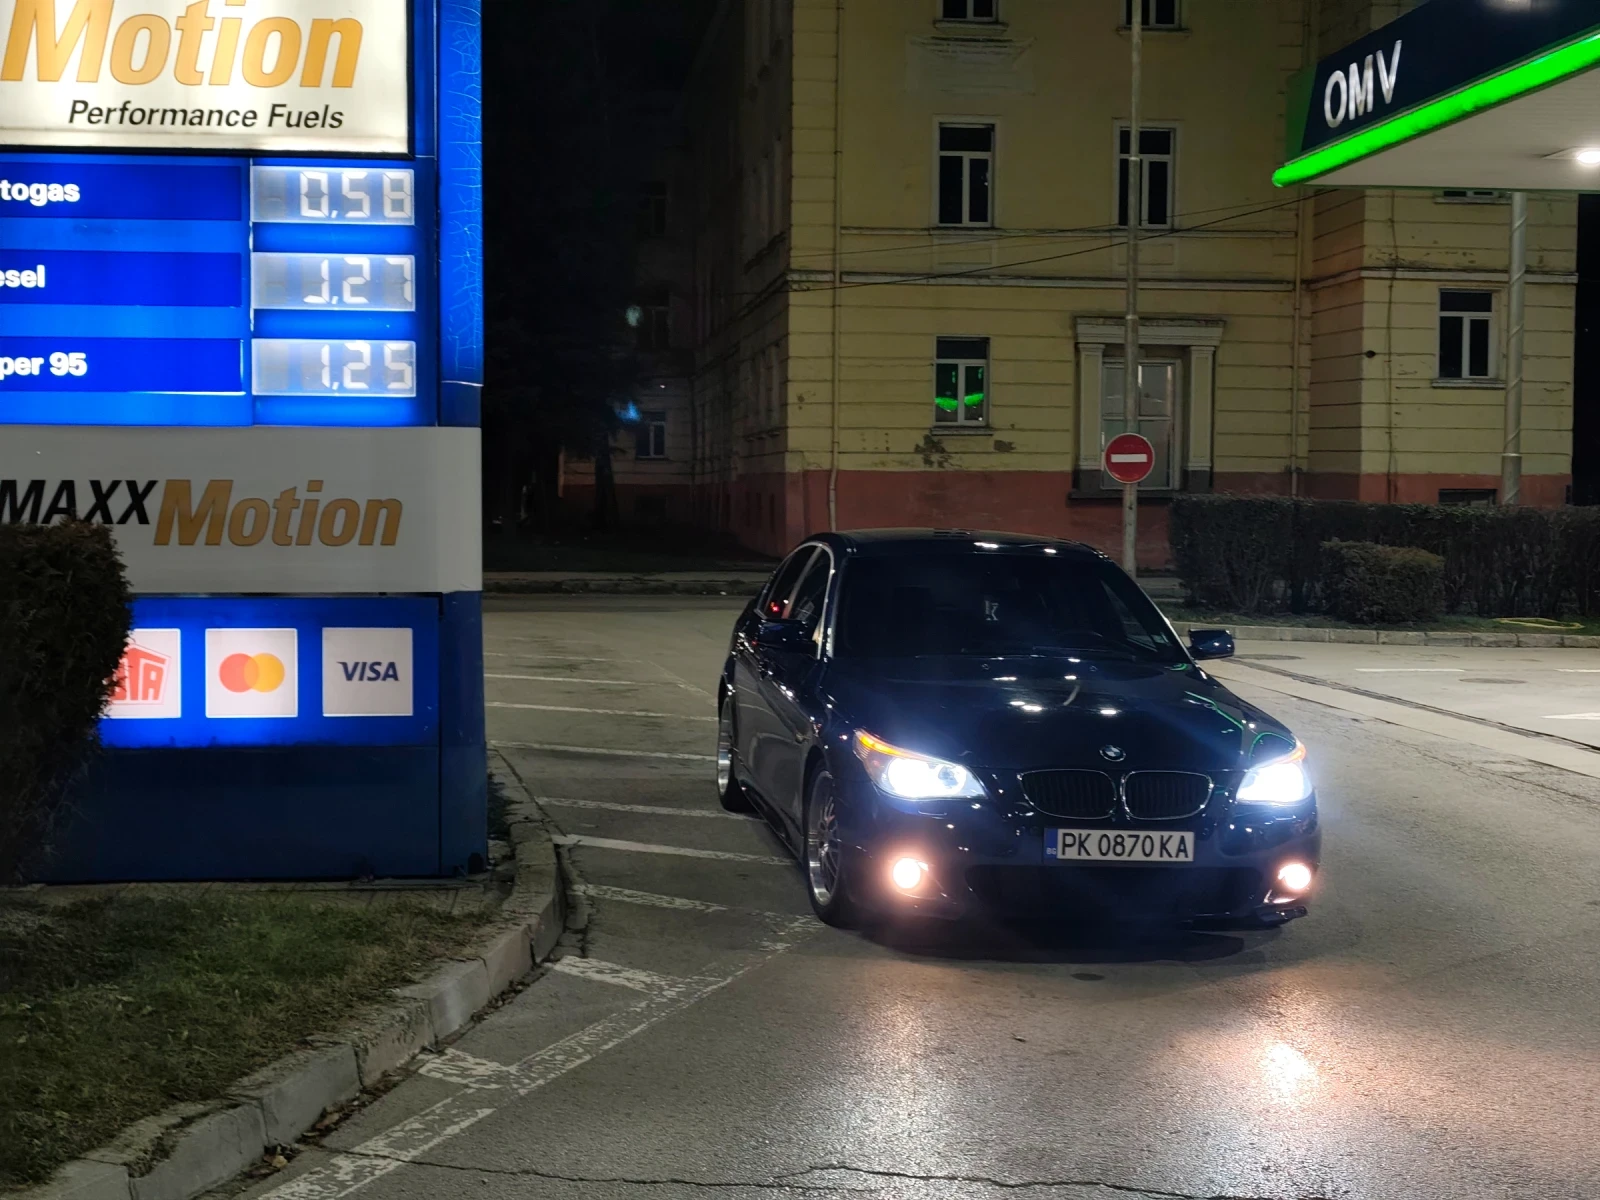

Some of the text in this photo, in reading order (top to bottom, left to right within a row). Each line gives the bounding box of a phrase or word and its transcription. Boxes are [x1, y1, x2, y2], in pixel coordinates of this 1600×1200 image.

[0, 0, 364, 88] Motion
[1324, 40, 1402, 128] OMV
[68, 99, 344, 129] Performance Fuels
[300, 171, 411, 218] 0,58
[49, 351, 87, 376] 95
[321, 342, 412, 390] 1,25
[337, 662, 399, 681] VISA
